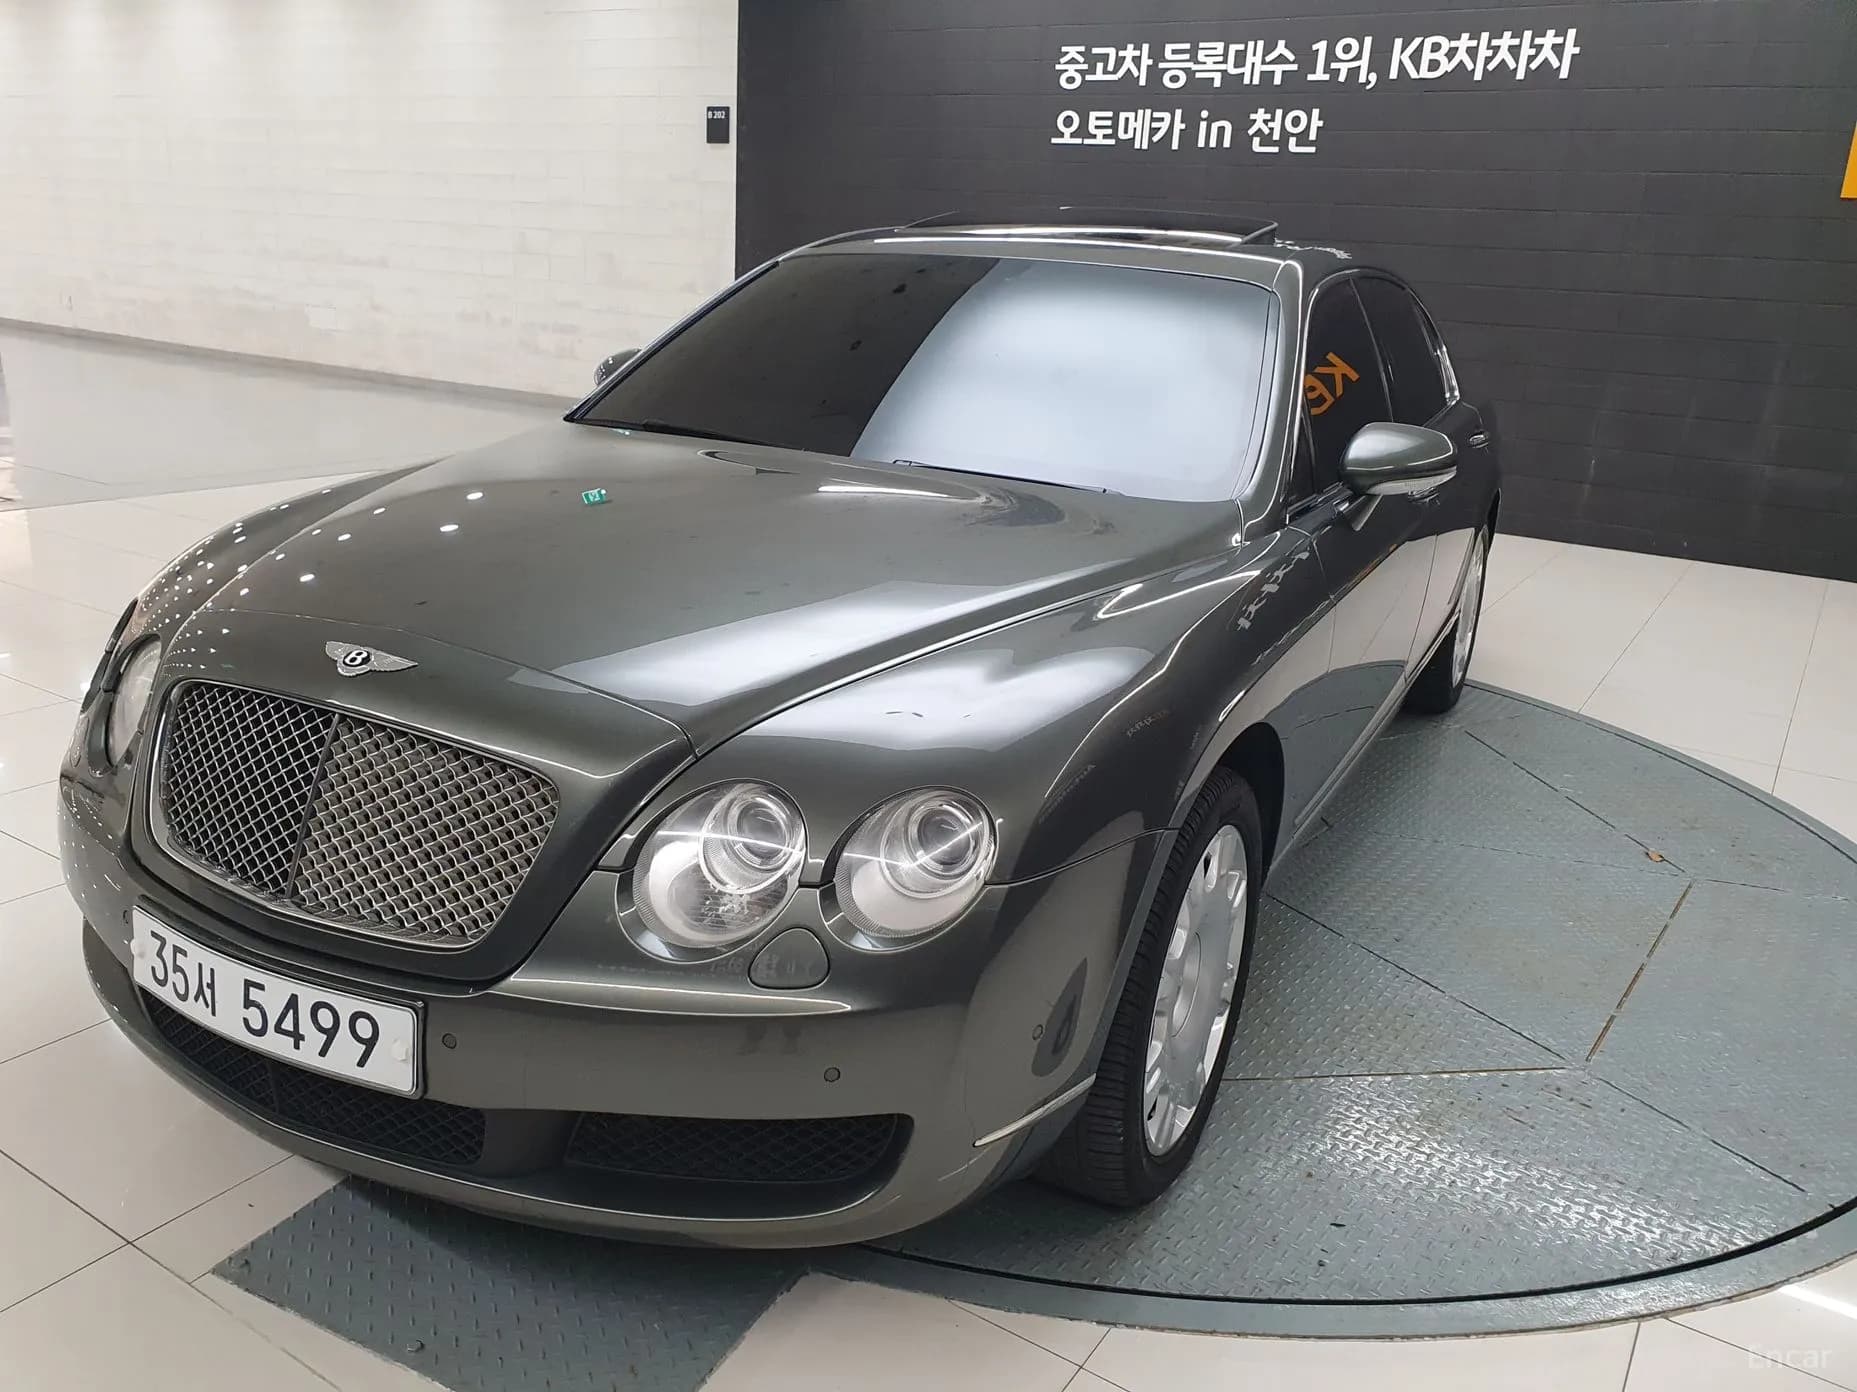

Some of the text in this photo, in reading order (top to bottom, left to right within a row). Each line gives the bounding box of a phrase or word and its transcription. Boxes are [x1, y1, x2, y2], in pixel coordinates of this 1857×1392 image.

[1054, 27, 1581, 90] 중고차 등록대수 1위, KB차차차
[1050, 107, 1324, 153] 오토메카 in 천안
[149, 930, 380, 1068] 35서 5499
